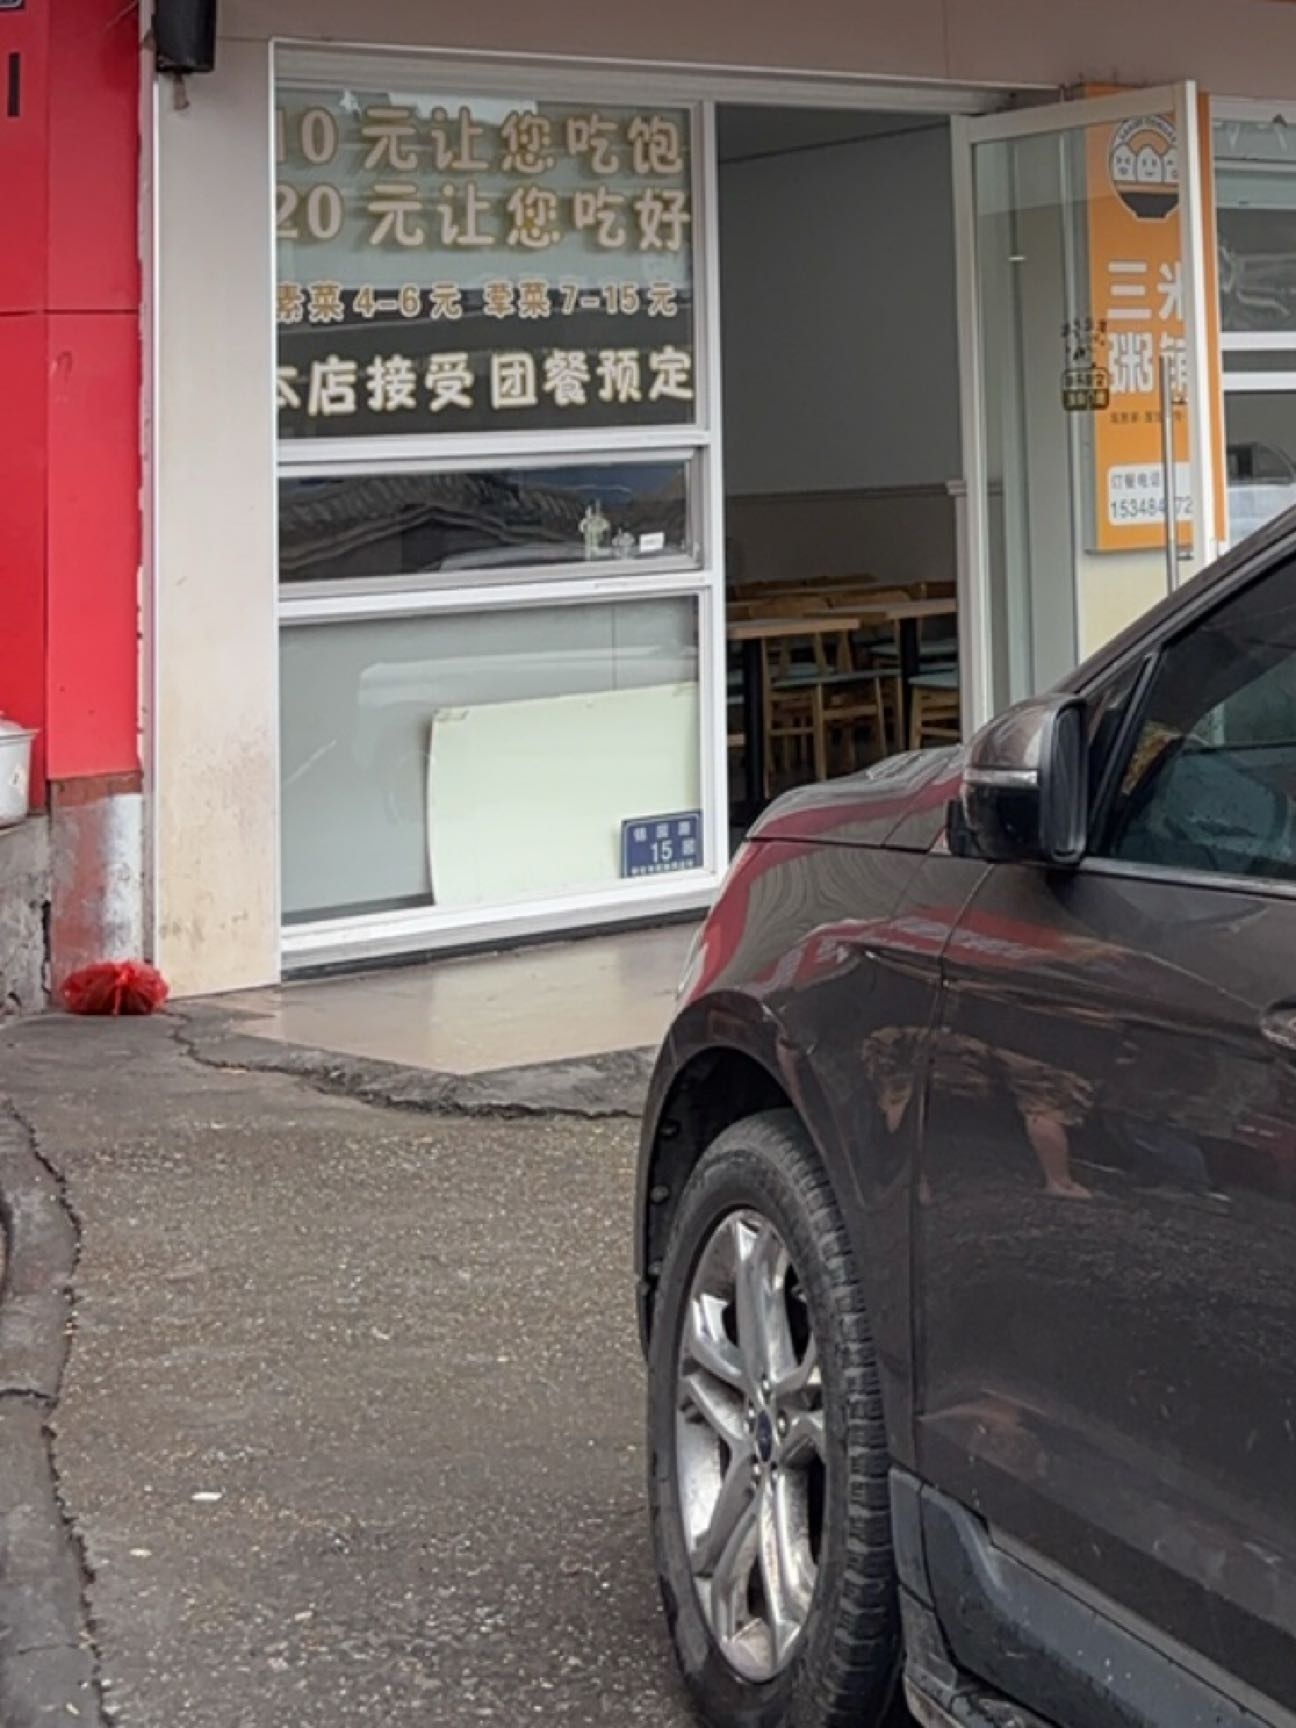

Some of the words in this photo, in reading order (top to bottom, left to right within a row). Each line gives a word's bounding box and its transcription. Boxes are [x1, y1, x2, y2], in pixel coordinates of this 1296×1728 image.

[276, 182, 690, 251] 20元让您吃好
